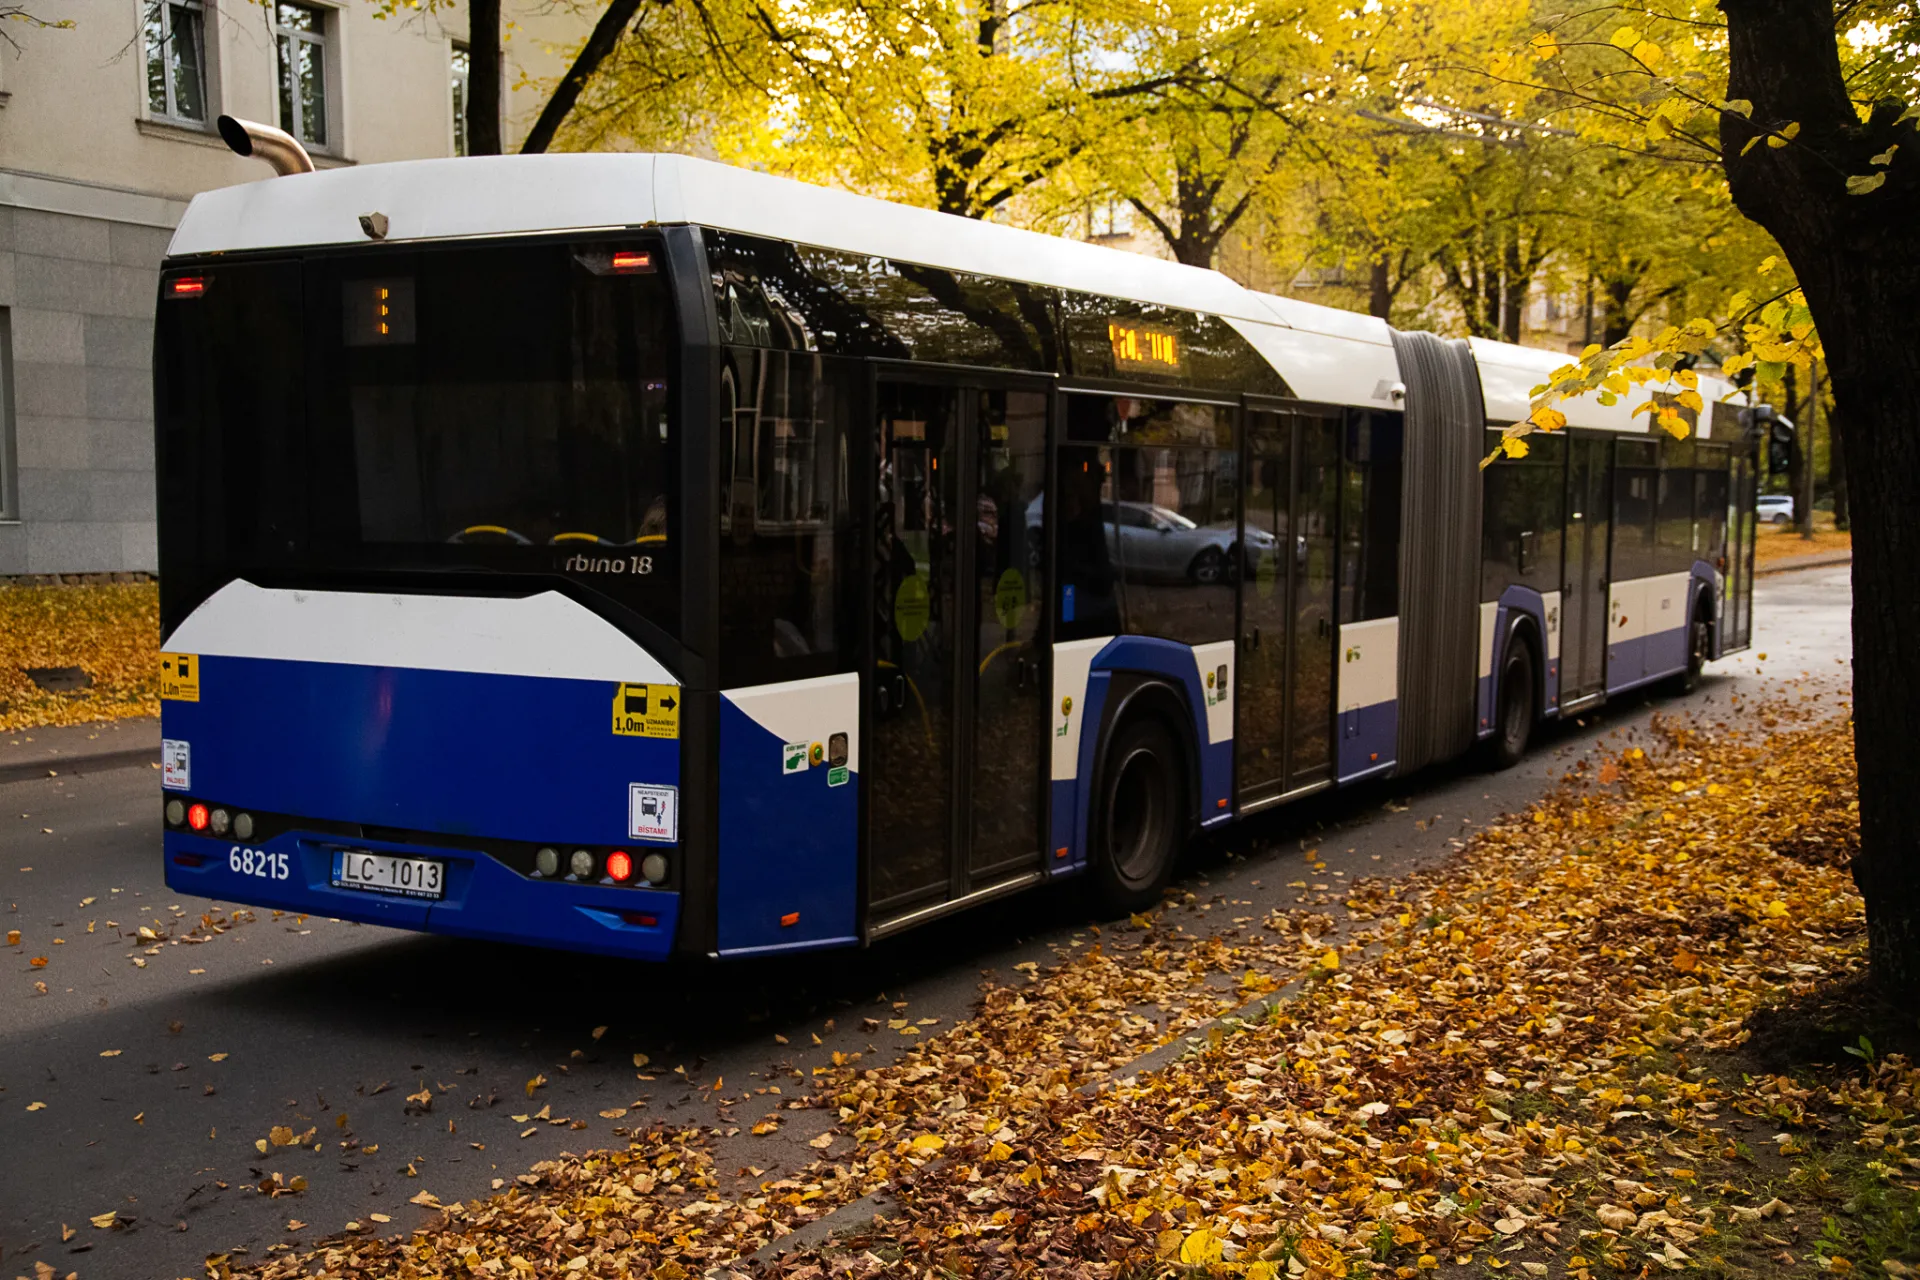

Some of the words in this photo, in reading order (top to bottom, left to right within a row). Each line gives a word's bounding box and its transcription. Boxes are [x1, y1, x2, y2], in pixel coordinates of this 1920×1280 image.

[565, 553, 626, 573] rbino
[630, 555, 653, 575] 18
[615, 716, 645, 734] 1,0m
[229, 845, 290, 881] 68215
[346, 854, 439, 889] LC-1013
